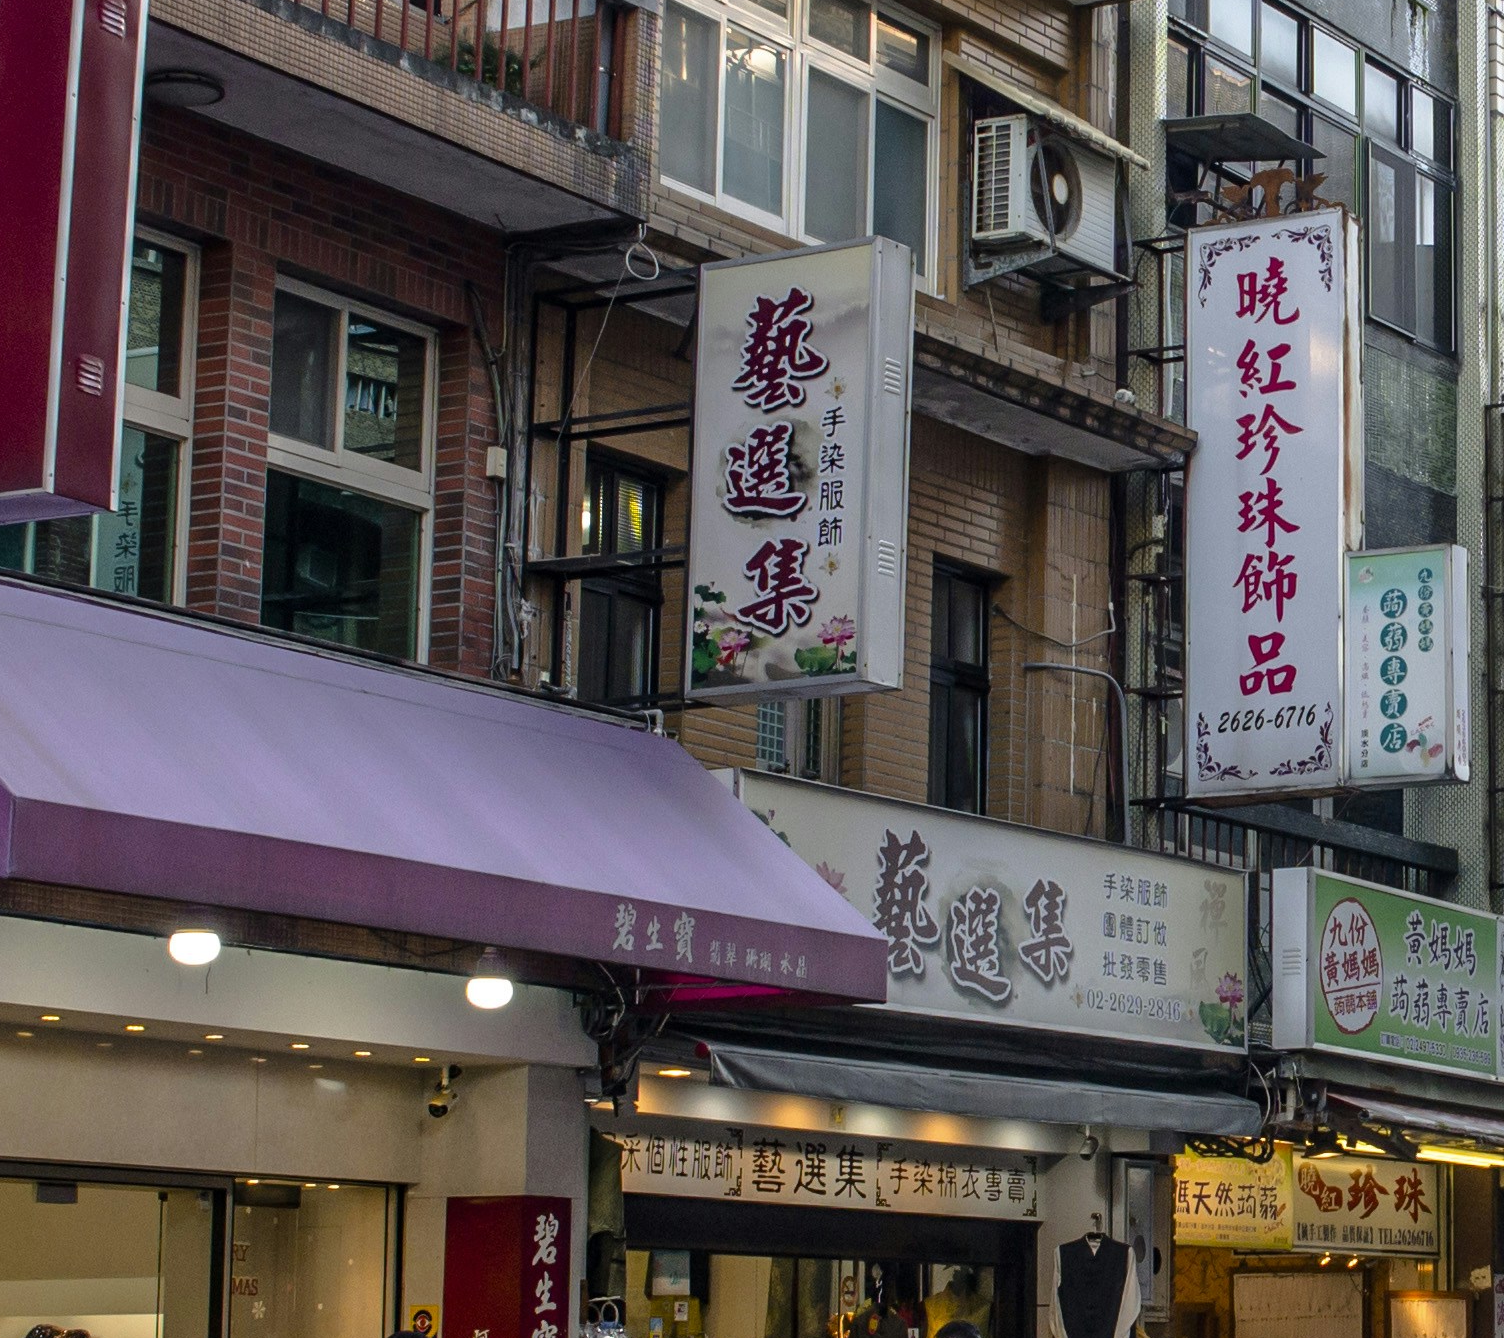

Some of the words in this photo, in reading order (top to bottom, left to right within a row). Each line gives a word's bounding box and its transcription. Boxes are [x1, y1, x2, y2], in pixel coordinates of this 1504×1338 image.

[723, 286, 830, 635] 藝選集
[819, 406, 846, 547] 手染服飾
[1233, 255, 1303, 697] 曉紅珍珠飾品
[1381, 588, 1407, 753] 蒟蒻專賣店
[1217, 704, 1316, 734] 2626-6716
[874, 832, 1073, 1002] 藝選集
[1103, 871, 1168, 908] 手染服飾
[613, 903, 696, 962] 碧生寶
[780, 952, 807, 979] 水晶
[1102, 910, 1168, 949] 團體訂做
[1330, 913, 1369, 949] 九份
[1404, 909, 1477, 978] 黃媽媽
[1102, 950, 1169, 987] 批發零售
[1324, 946, 1380, 988] 黃媽媽
[1085, 989, 1181, 1024] 02-2629-2846
[1390, 971, 1491, 1039] 蒟蒻專賣店
[604, 1131, 734, 1182] 采個性服飾
[752, 1137, 866, 1198] 藝選集
[891, 1157, 1027, 1203] 手染棉衣專賣
